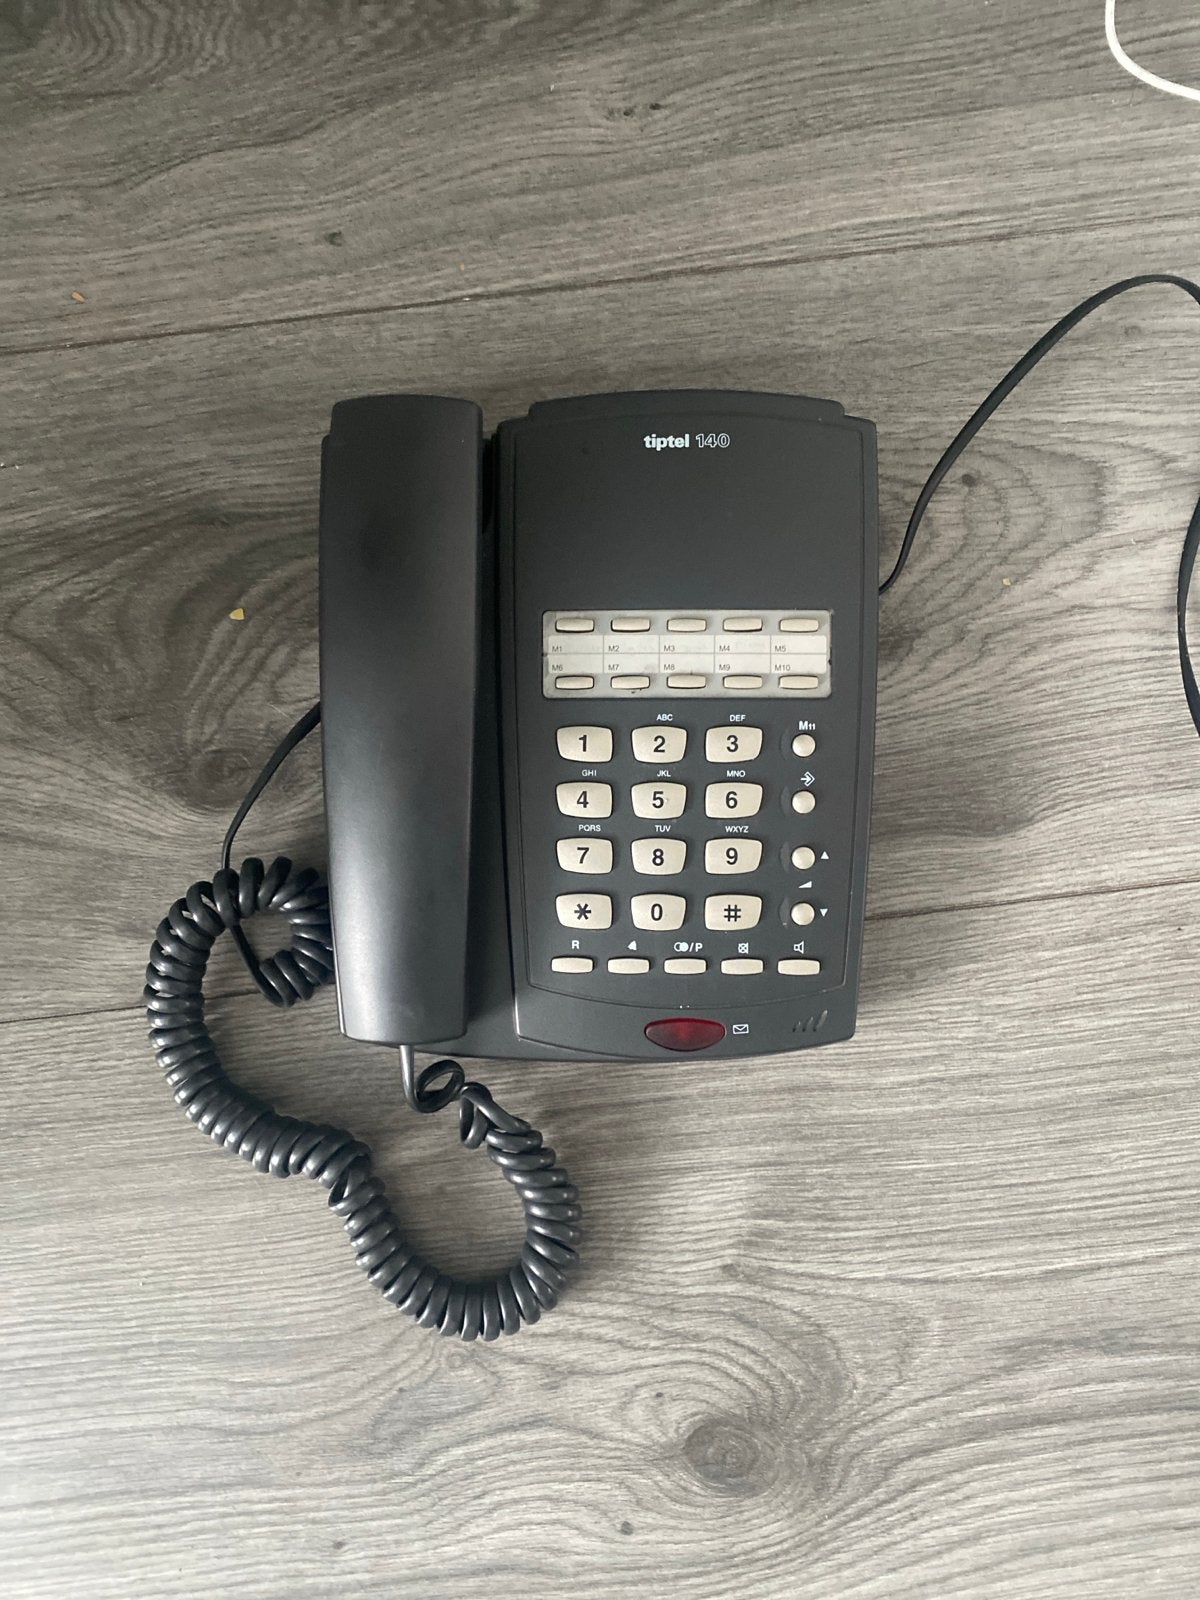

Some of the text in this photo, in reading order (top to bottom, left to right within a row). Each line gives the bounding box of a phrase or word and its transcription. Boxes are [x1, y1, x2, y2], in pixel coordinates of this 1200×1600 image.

[643, 433, 731, 452] tiptel 140
[552, 644, 563, 653] M1
[608, 644, 620, 653] M2
[663, 644, 676, 653] M3
[719, 644, 731, 653] M4
[774, 644, 787, 653] M5
[552, 663, 564, 672] M6
[608, 663, 620, 672] M7
[663, 663, 676, 672] M8
[719, 663, 731, 672] M9
[774, 663, 791, 672] M10
[656, 714, 673, 722] ABC
[729, 714, 746, 722] DEF
[798, 721, 816, 731] M11
[578, 734, 588, 752] 1
[653, 735, 666, 753] 2
[726, 735, 739, 753] 3
[581, 769, 597, 777] GHI
[656, 770, 671, 778] JKL
[726, 770, 746, 778] MNO
[576, 790, 590, 809] 4
[652, 791, 665, 809] 5
[725, 791, 738, 809] 6
[578, 824, 602, 832] PQRS
[654, 825, 671, 833] TUV
[724, 825, 749, 833] WXYZ
[576, 847, 590, 865] 7
[652, 848, 665, 867] 8
[725, 847, 739, 866] 9
[650, 903, 663, 922] 0
[723, 904, 742, 922] #
[571, 940, 580, 950] R
